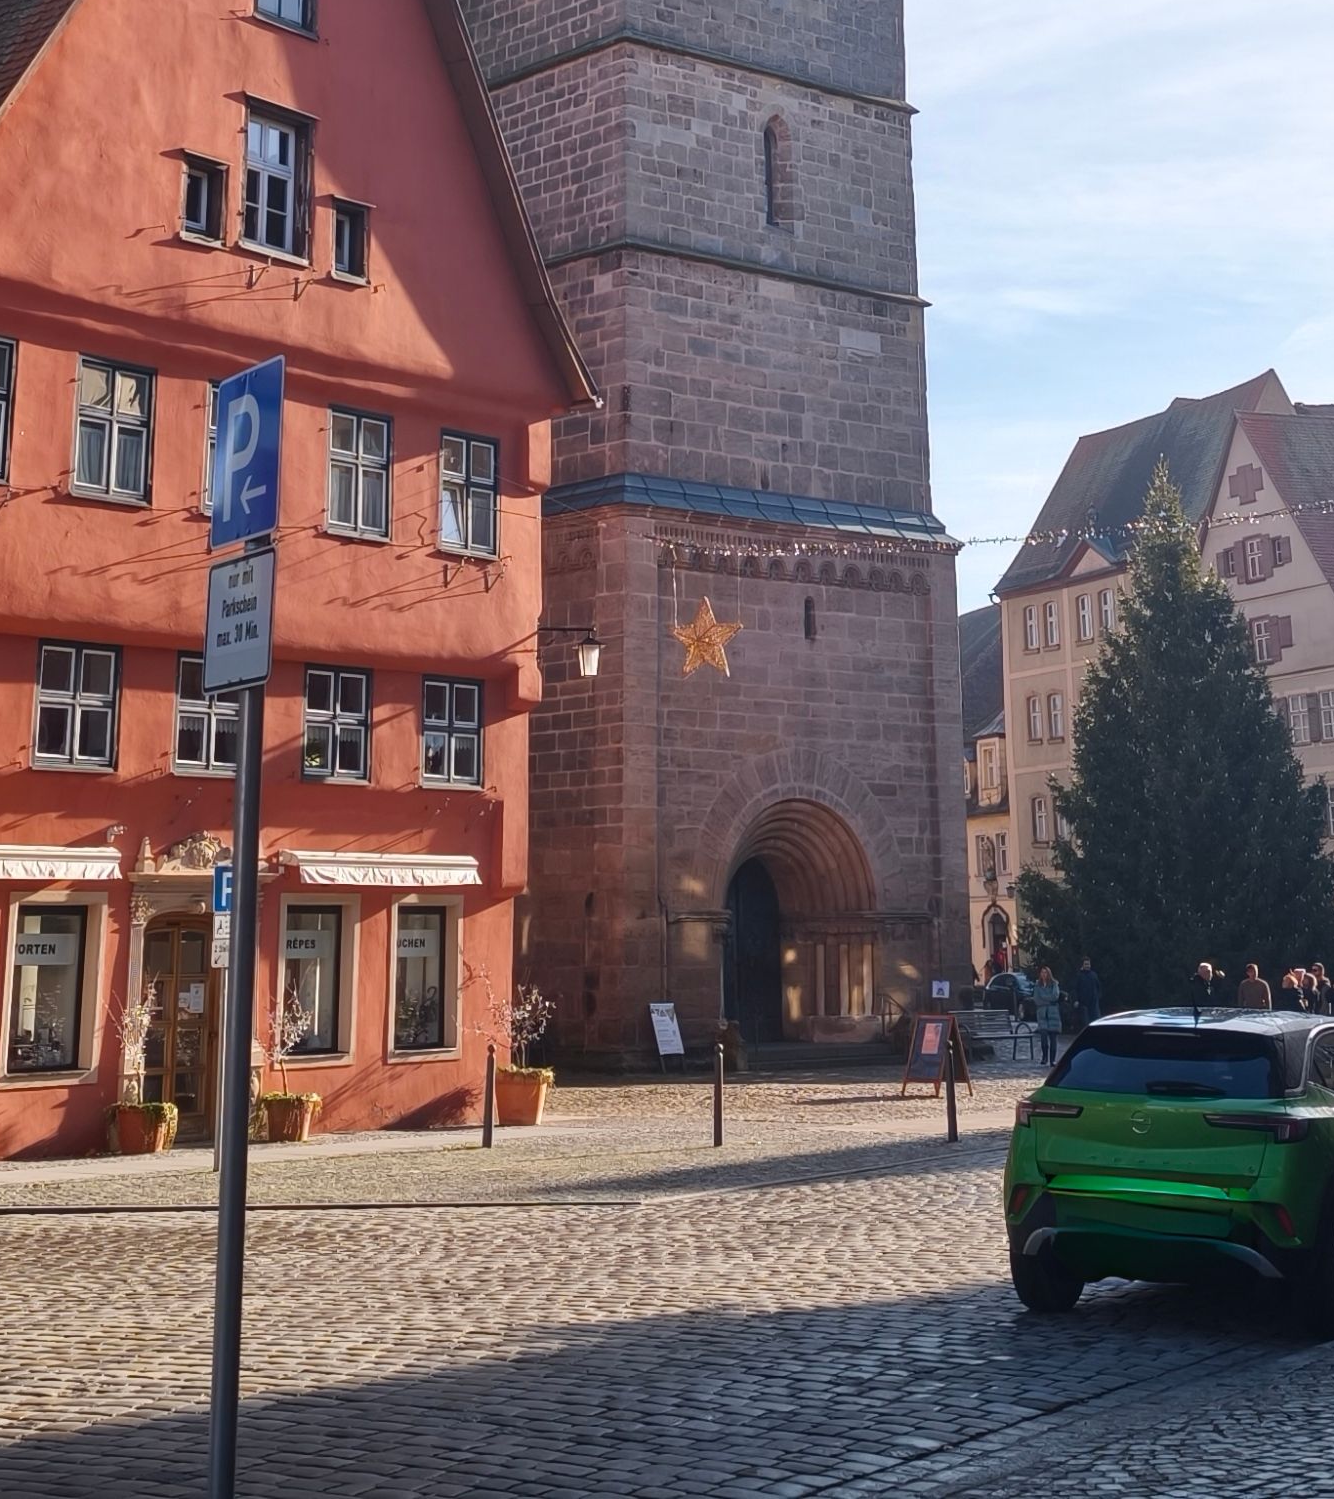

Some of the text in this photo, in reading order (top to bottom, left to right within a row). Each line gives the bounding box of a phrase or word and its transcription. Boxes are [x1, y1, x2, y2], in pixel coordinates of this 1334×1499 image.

[223, 394, 260, 522] P
[229, 565, 254, 589] nur mit
[221, 593, 257, 619] Parkschein
[216, 620, 259, 648] max. 30 Min.
[286, 938, 316, 949] RÊPES
